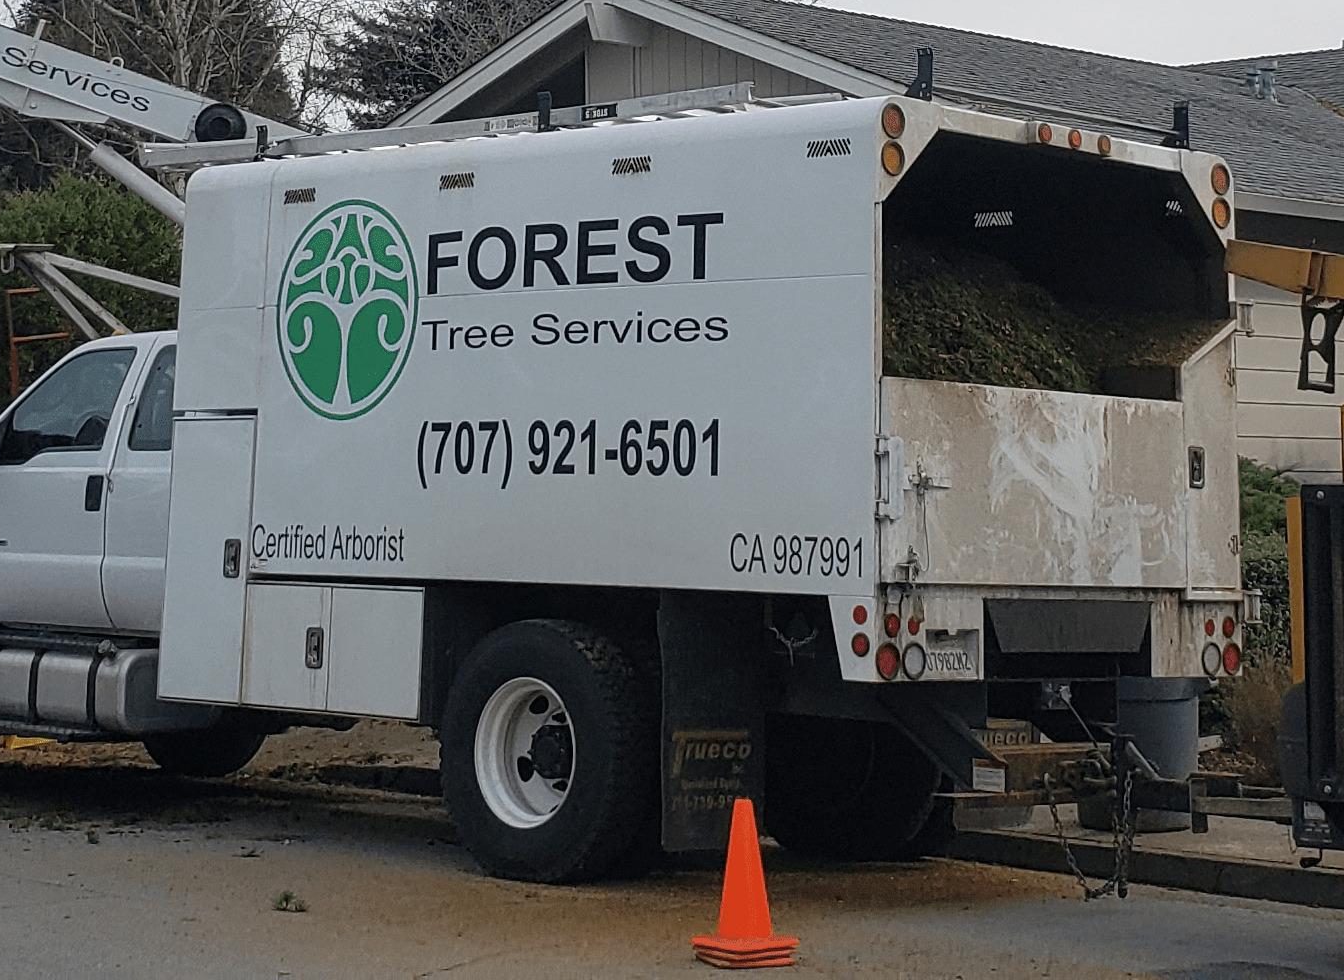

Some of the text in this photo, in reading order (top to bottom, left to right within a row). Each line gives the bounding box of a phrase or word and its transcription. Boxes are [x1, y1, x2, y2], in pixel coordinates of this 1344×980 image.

[1, 46, 151, 112] Services
[427, 212, 724, 295] FOREST
[421, 310, 729, 351] Tree Services
[417, 418, 719, 490] (707) 921-6501
[252, 523, 405, 562] Certified Arborist
[730, 532, 863, 578] CA 987991
[670, 729, 752, 777] Trueco
